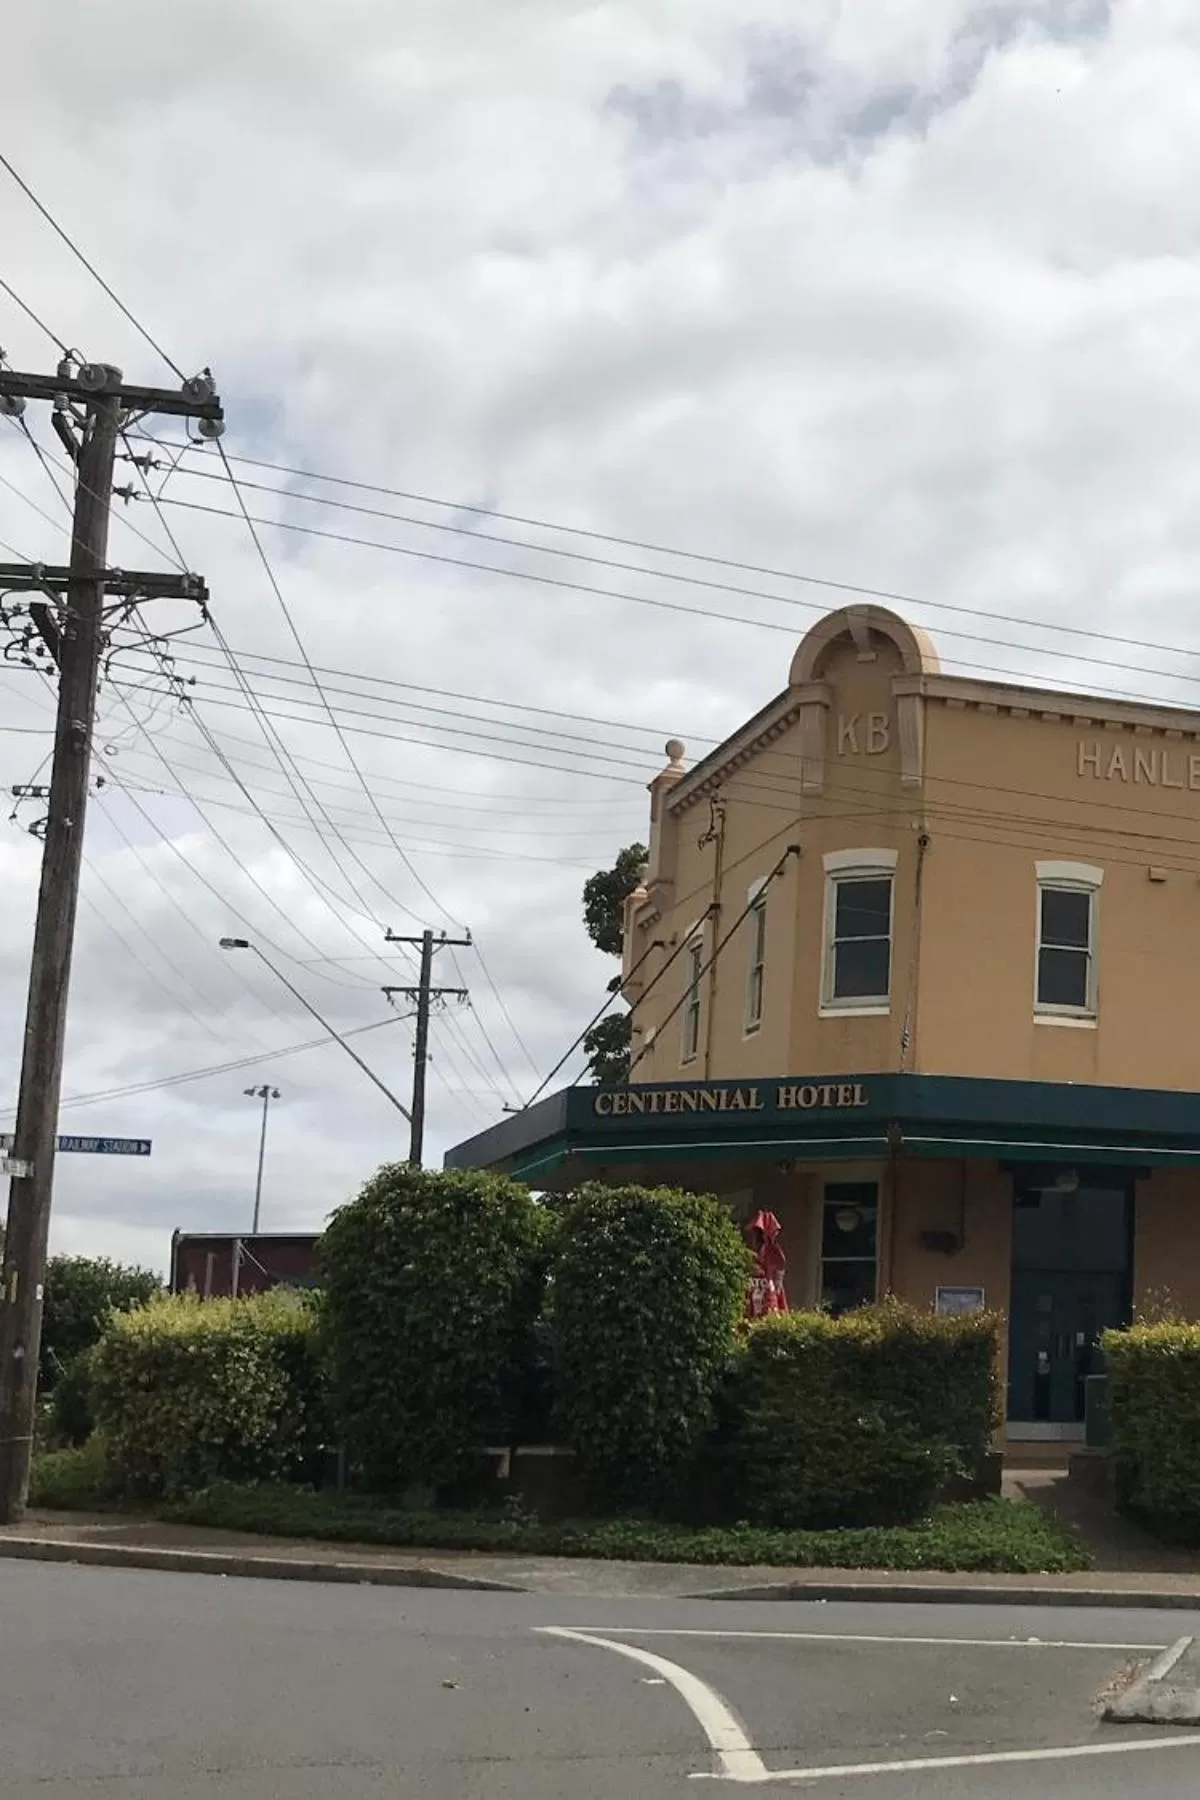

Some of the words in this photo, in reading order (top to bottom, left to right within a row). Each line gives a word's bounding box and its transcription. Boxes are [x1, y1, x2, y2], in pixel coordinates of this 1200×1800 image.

[837, 711, 889, 756] KB
[594, 1086, 764, 1116] CENTENNIAL
[776, 1083, 869, 1109] HOTEL
[60, 1136, 99, 1150] RAILWAY
[103, 1139, 138, 1153] STATION
